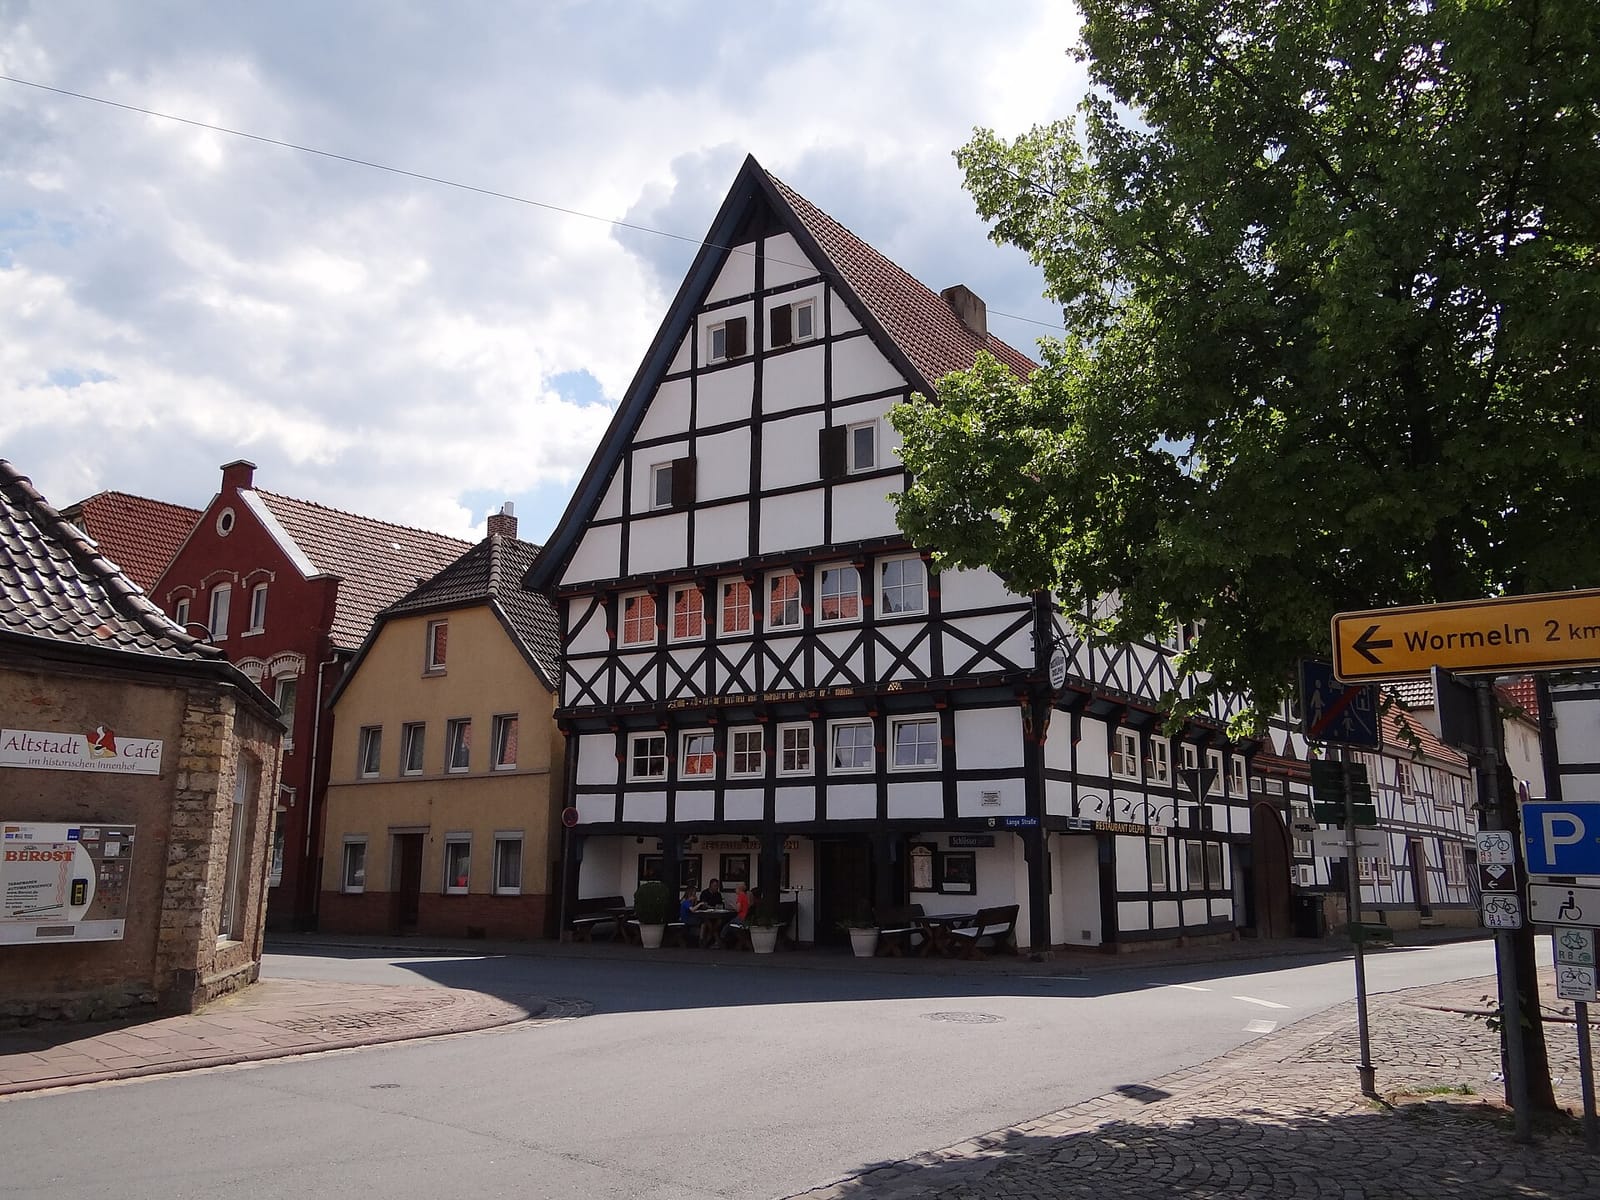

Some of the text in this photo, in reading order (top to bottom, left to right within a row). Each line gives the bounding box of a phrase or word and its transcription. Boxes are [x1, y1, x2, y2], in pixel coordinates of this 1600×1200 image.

[1404, 619, 1600, 652] Wormeln 2 km
[4, 733, 160, 759] Altstadt Café
[28, 756, 137, 771] im historischen Innenhof
[1006, 818, 1037, 826] Lange Straße
[1095, 820, 1128, 833] RESTAURANT
[1541, 812, 1586, 866] P
[4, 850, 75, 862] BEROST
